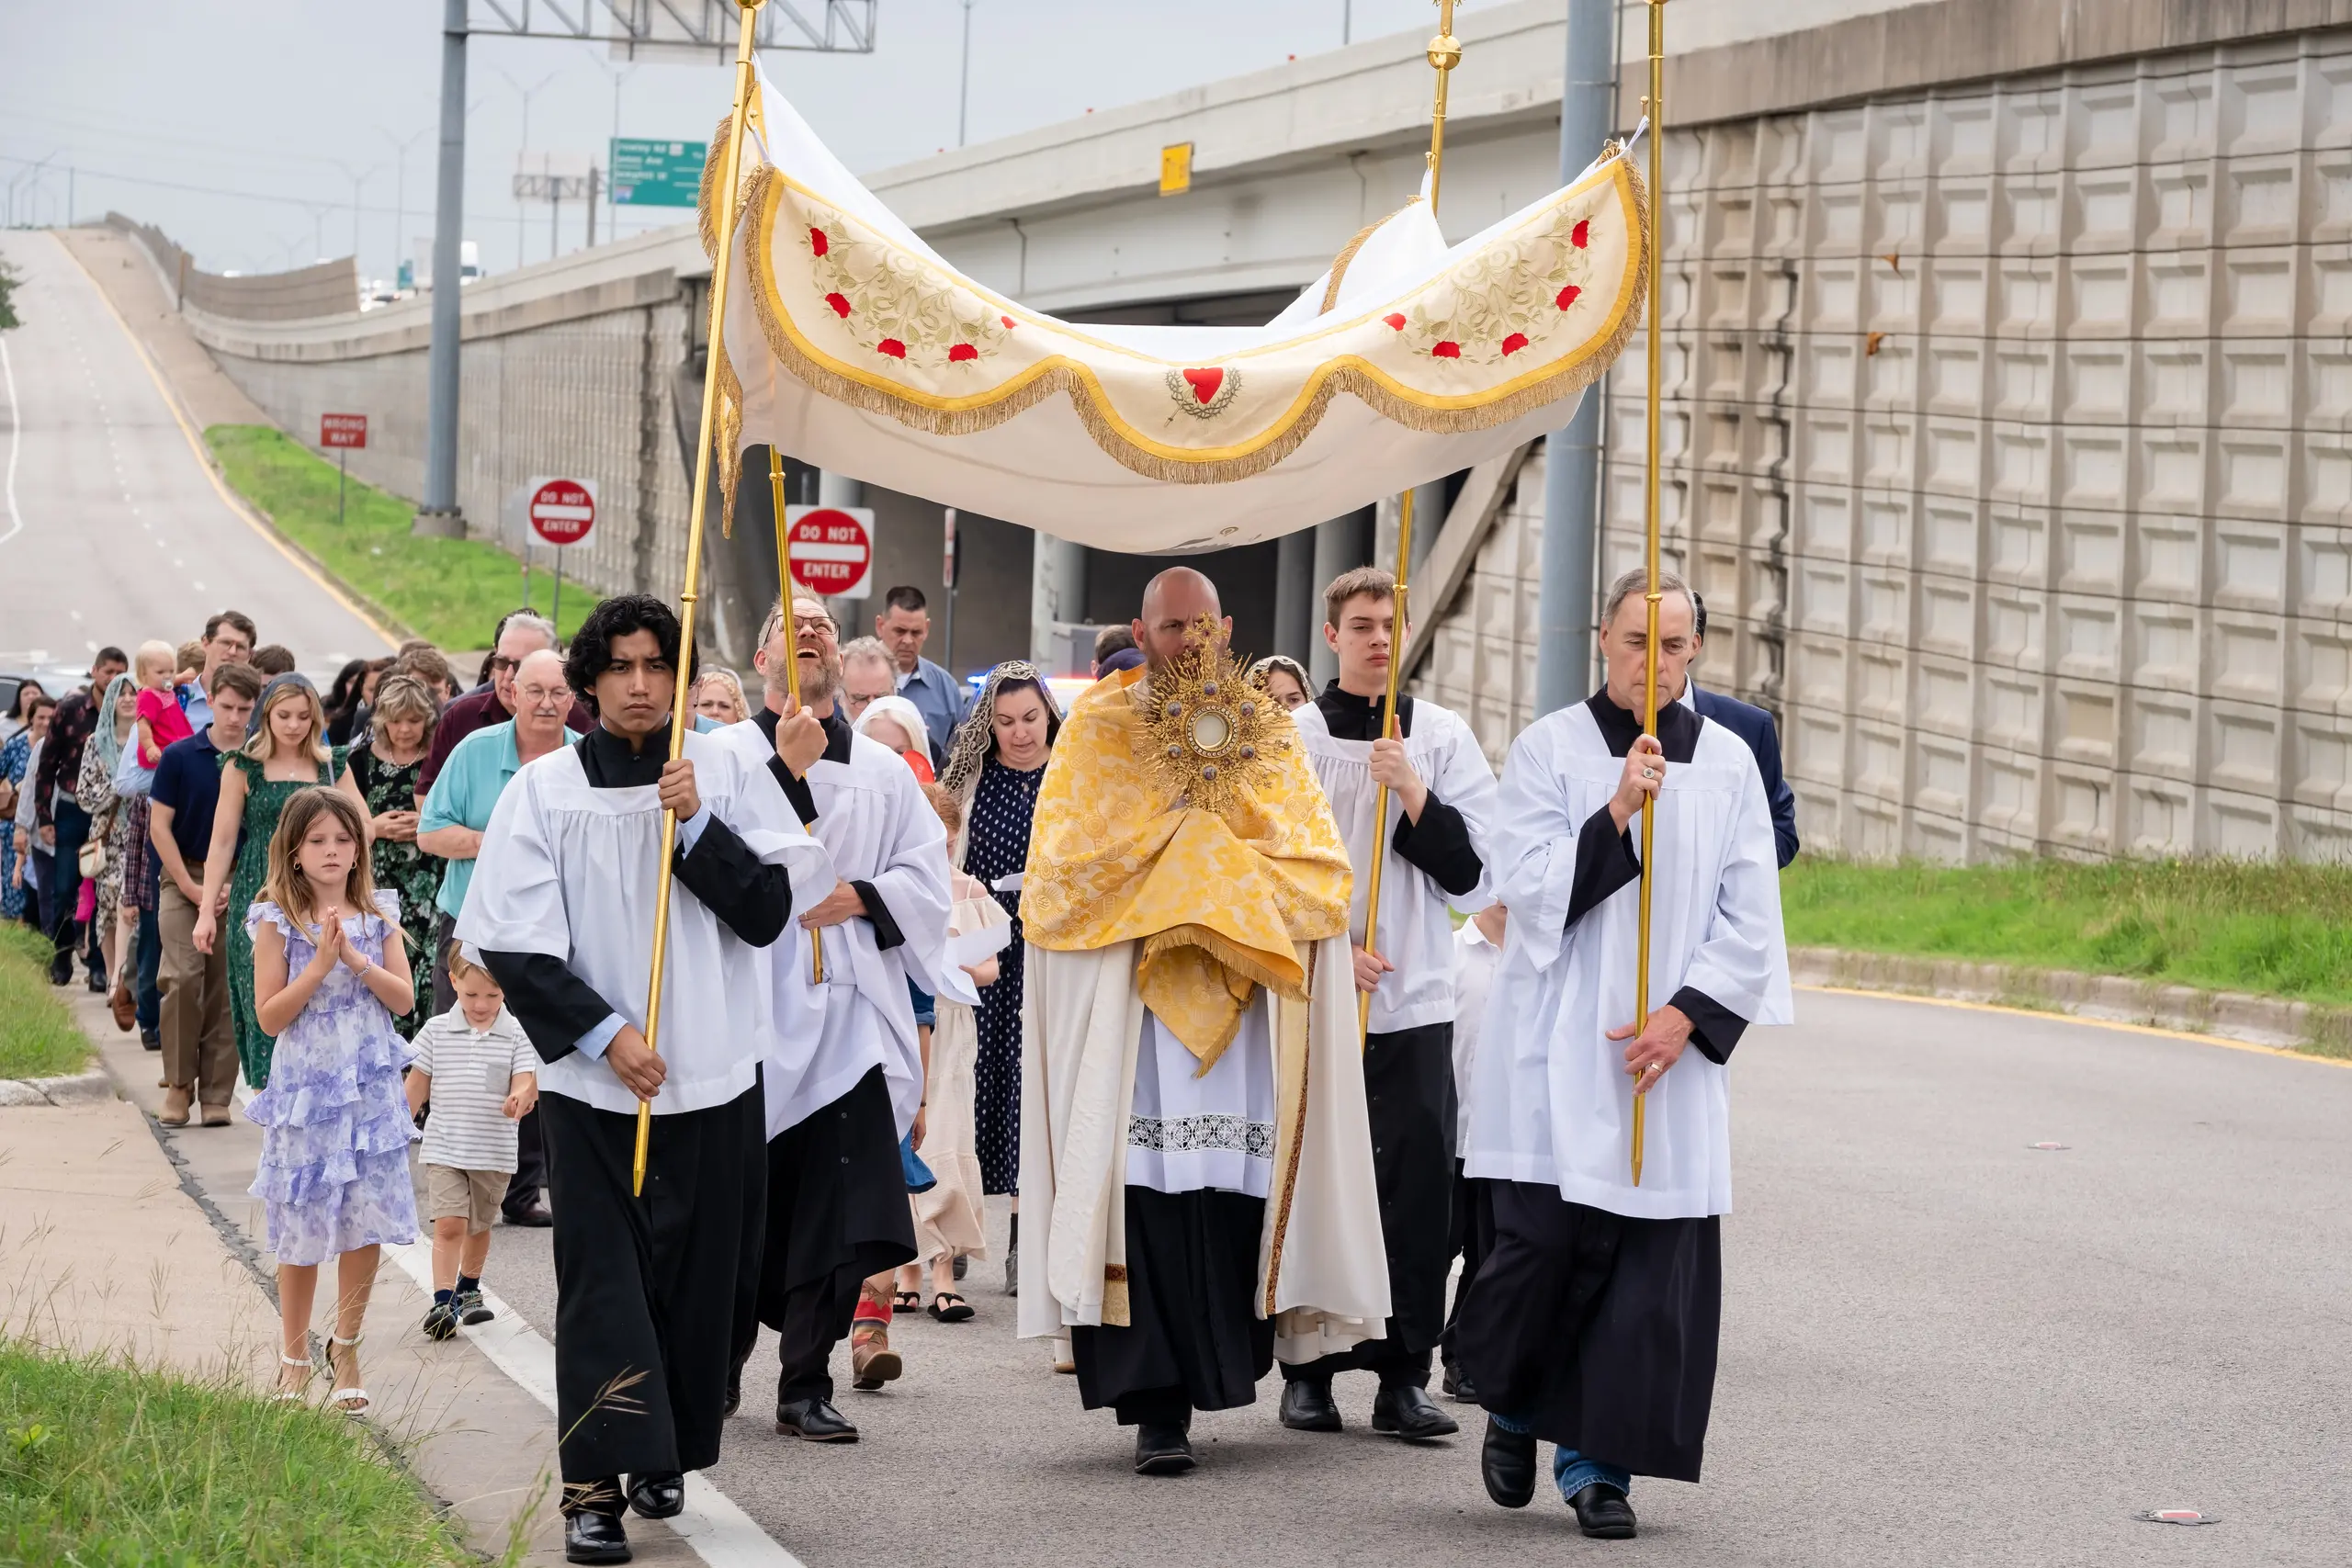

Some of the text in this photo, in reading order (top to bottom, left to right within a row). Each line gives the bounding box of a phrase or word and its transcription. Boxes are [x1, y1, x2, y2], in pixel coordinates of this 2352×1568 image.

[323, 417, 364, 431] WRONG
[331, 433, 356, 445] WAY
[540, 491, 584, 505] DO NOT
[543, 519, 580, 533] ENTER
[799, 525, 857, 542] DO NOT
[803, 562, 850, 579] ENTER
